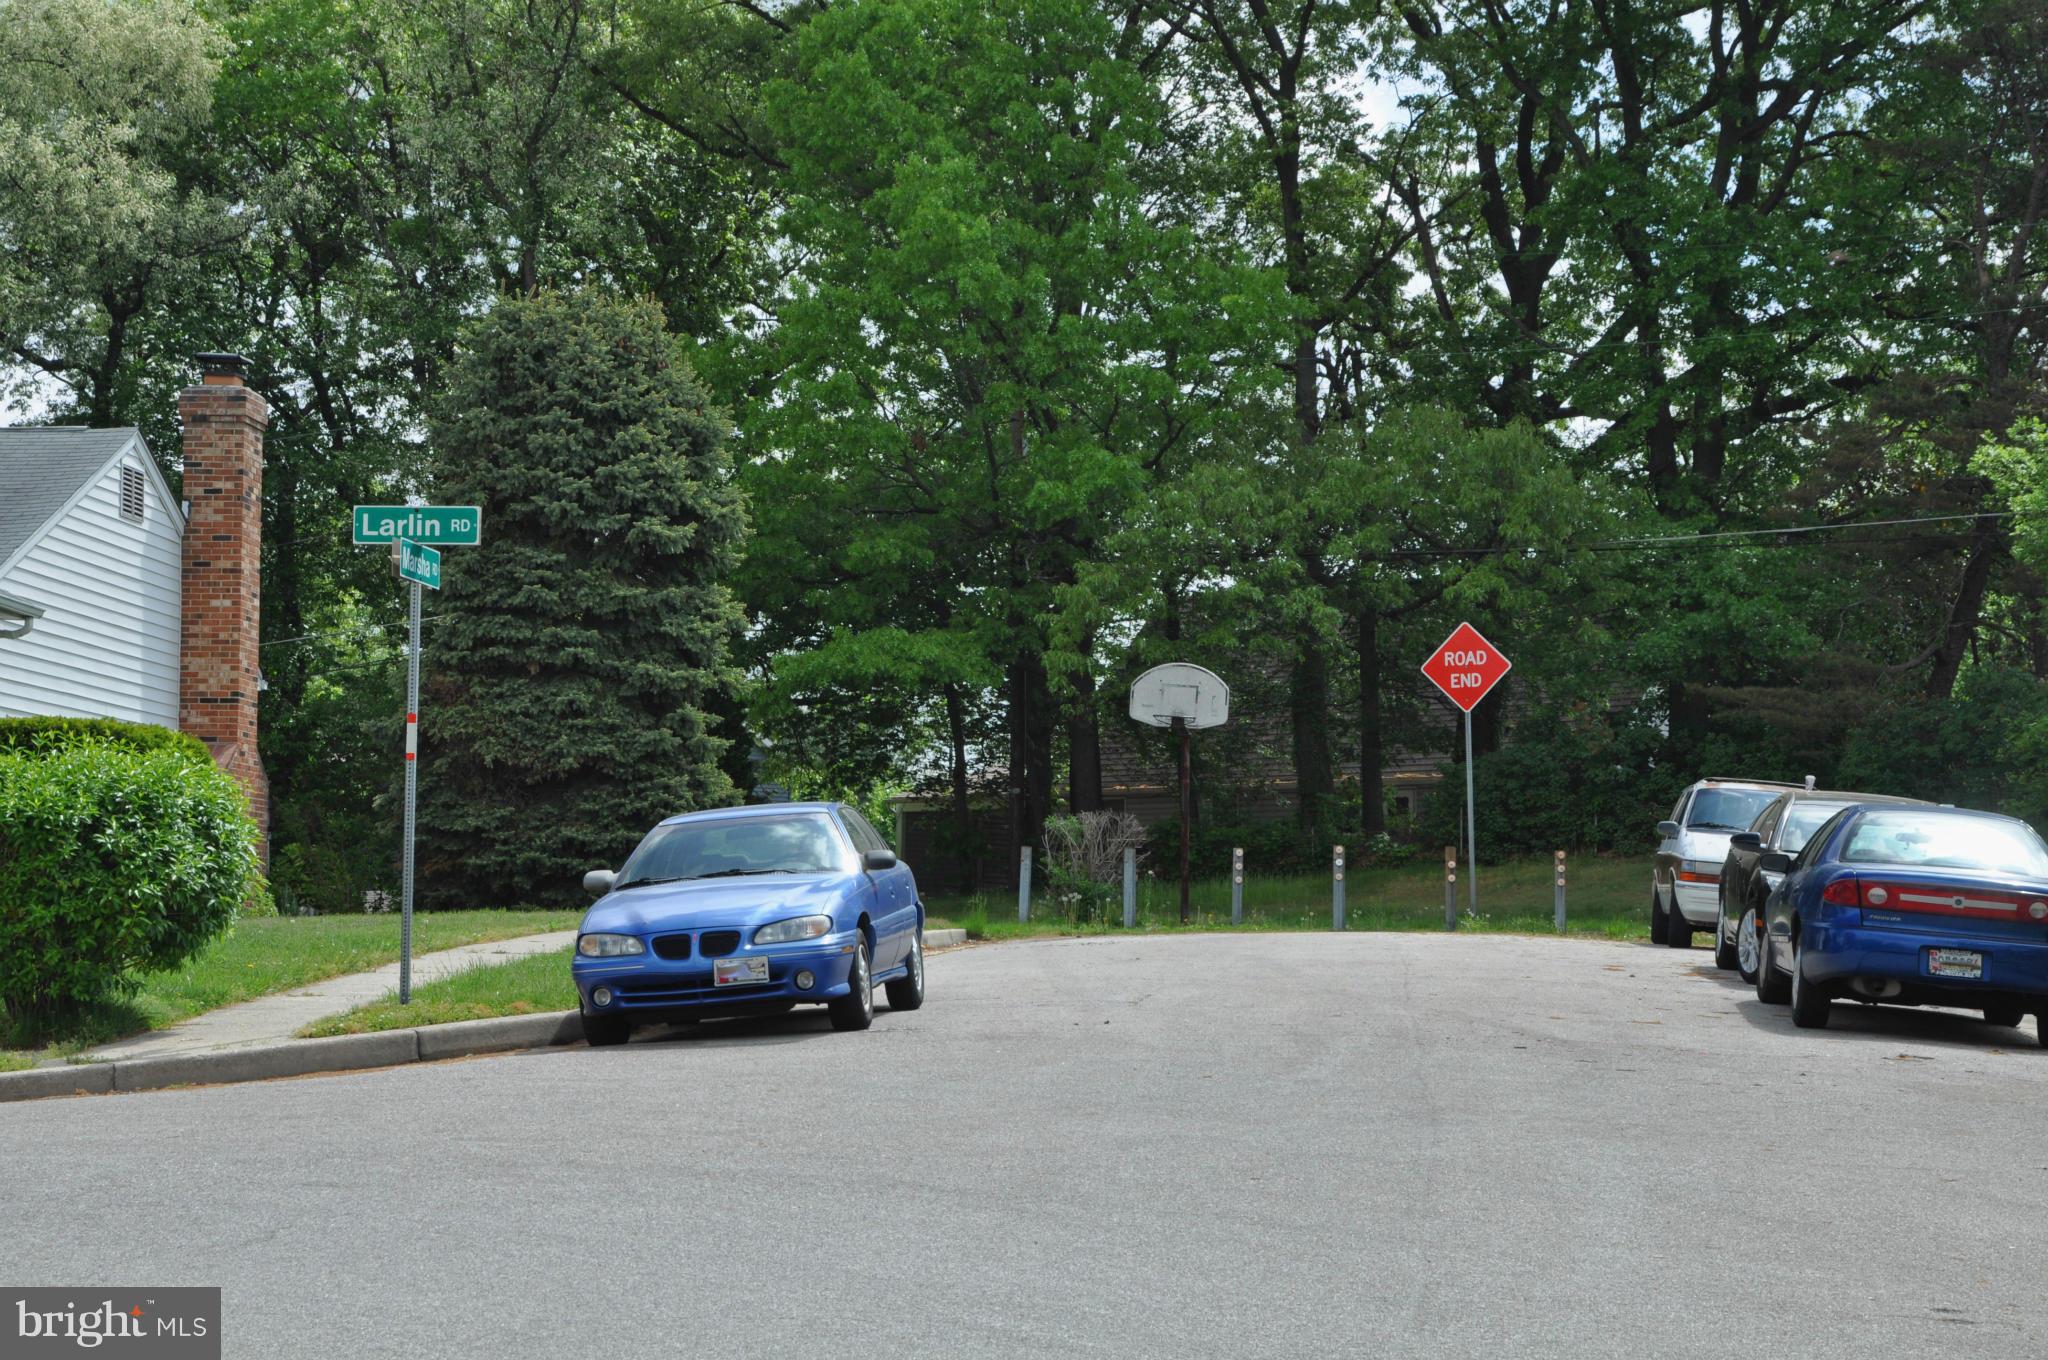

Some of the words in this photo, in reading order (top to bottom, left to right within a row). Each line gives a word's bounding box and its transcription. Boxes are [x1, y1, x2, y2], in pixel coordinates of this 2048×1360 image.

[362, 513, 440, 536] Larlin
[450, 519, 471, 532] RD
[402, 546, 431, 578] Marsha
[1444, 650, 1487, 667] ROAD
[1450, 672, 1482, 689] END
